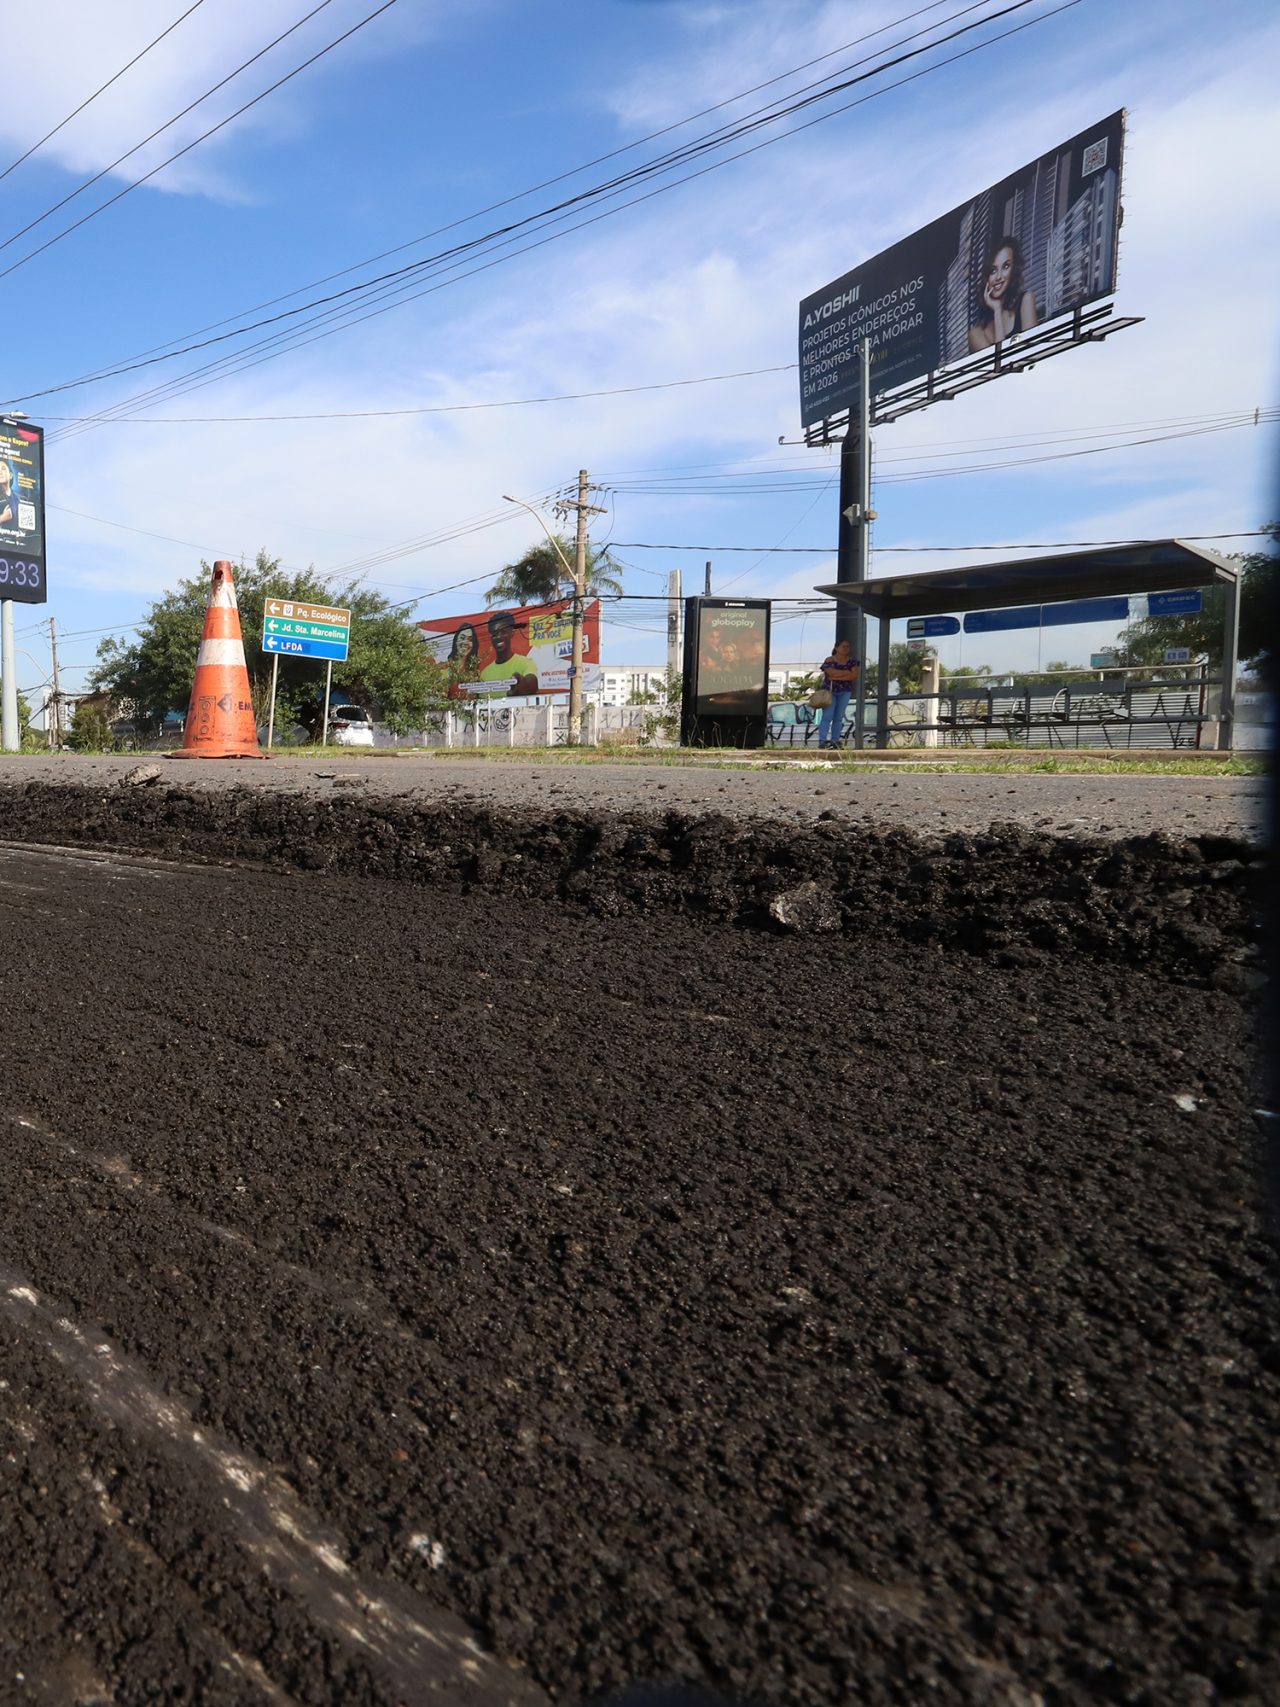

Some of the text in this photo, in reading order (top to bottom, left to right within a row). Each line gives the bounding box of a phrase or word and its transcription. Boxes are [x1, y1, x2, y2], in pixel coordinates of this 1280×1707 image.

[802, 317, 846, 352] PROJETOS
[899, 275, 925, 297] NOS
[803, 284, 862, 330] A.YOSHII
[802, 297, 916, 367] MELHORES ENDEREÇOS
[803, 370, 809, 382] E
[809, 348, 851, 380] PRONTOS
[882, 311, 924, 343] MORAR
[803, 382, 816, 398] EM
[817, 370, 839, 392] 2026
[297, 607, 347, 623] Pq. Ecológico
[711, 618, 756, 628] globoplay
[281, 623, 346, 640] Jd. Sta. Marcelina
[280, 641, 303, 652] LFDA
